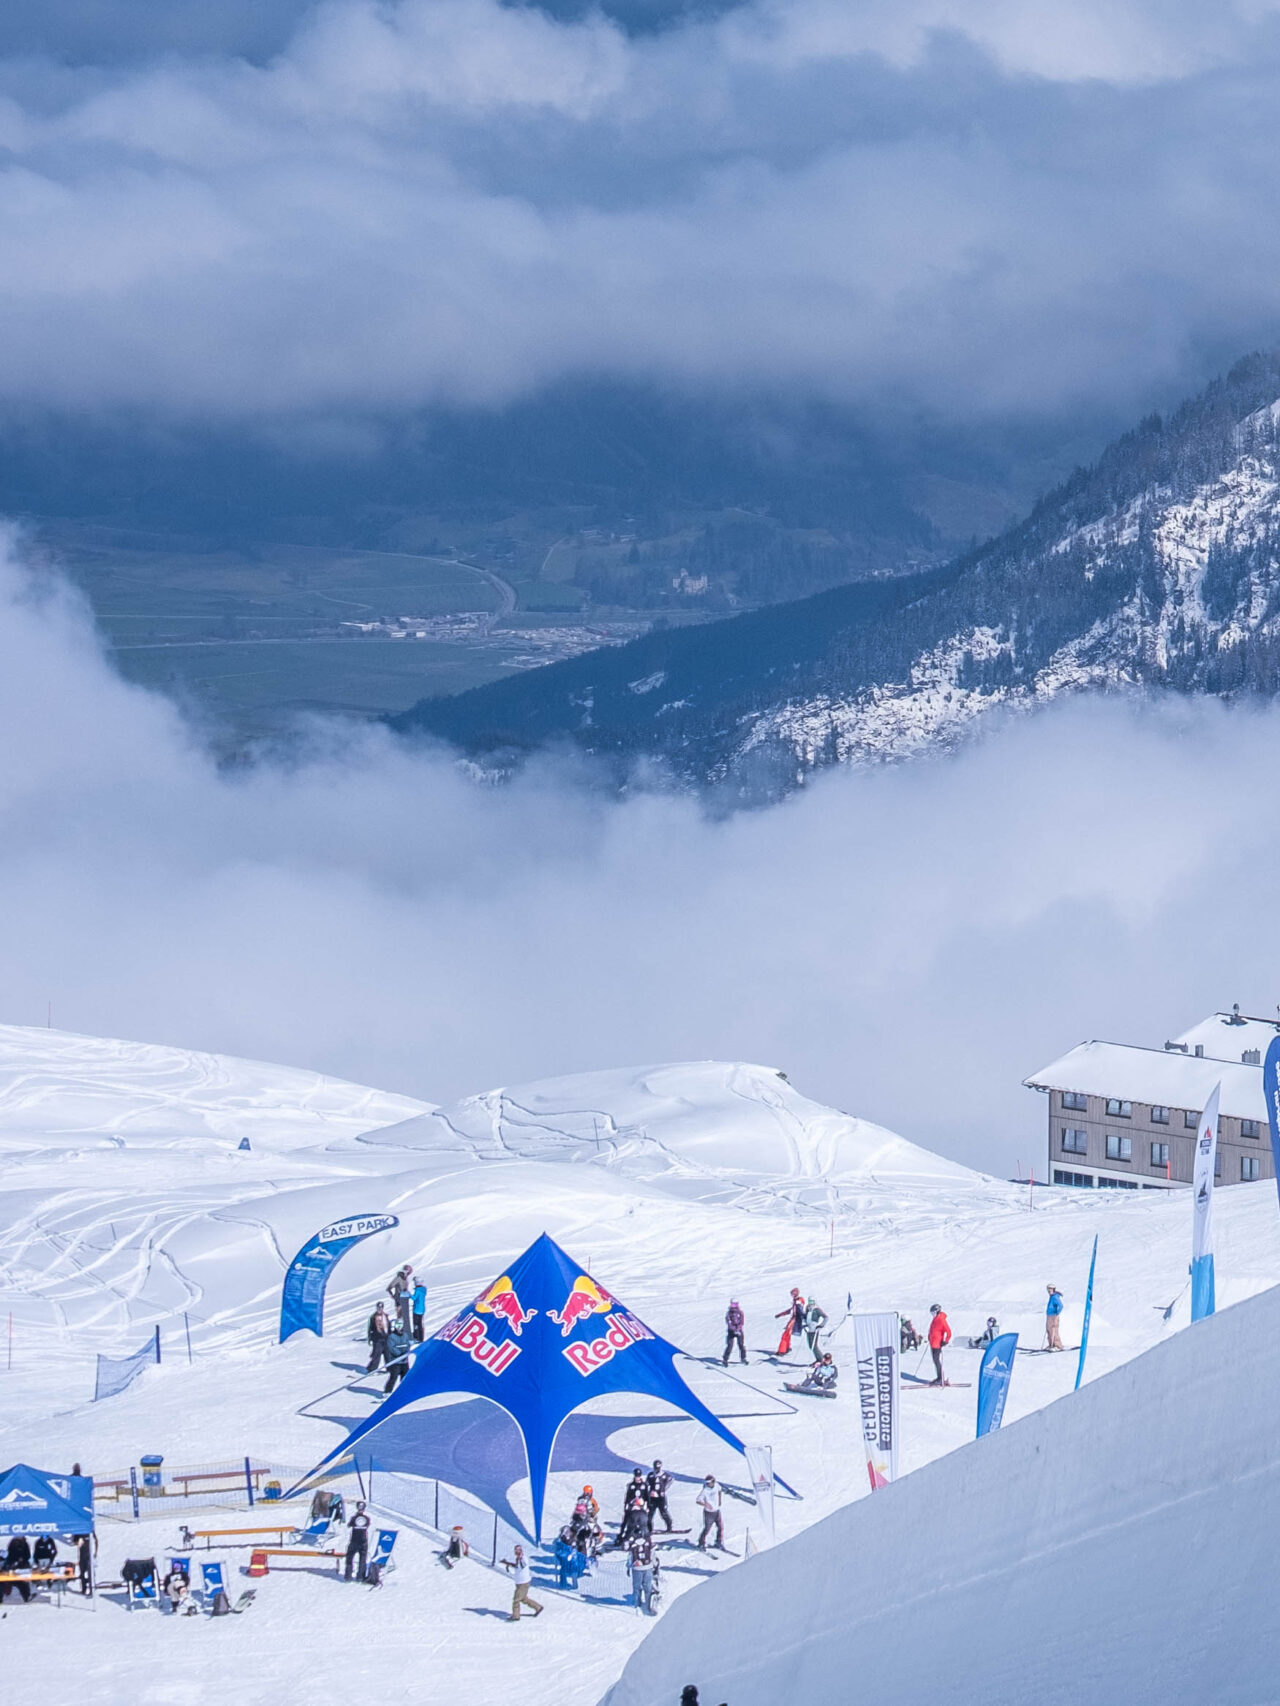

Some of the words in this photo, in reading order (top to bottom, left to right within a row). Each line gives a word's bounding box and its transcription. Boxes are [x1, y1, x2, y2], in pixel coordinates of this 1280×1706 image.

[321, 1224, 352, 1239] EASY
[358, 1216, 390, 1233] PARK
[453, 1317, 521, 1375] Bull
[563, 1315, 634, 1375] Red
[11, 1522, 59, 1533] GLACIER
